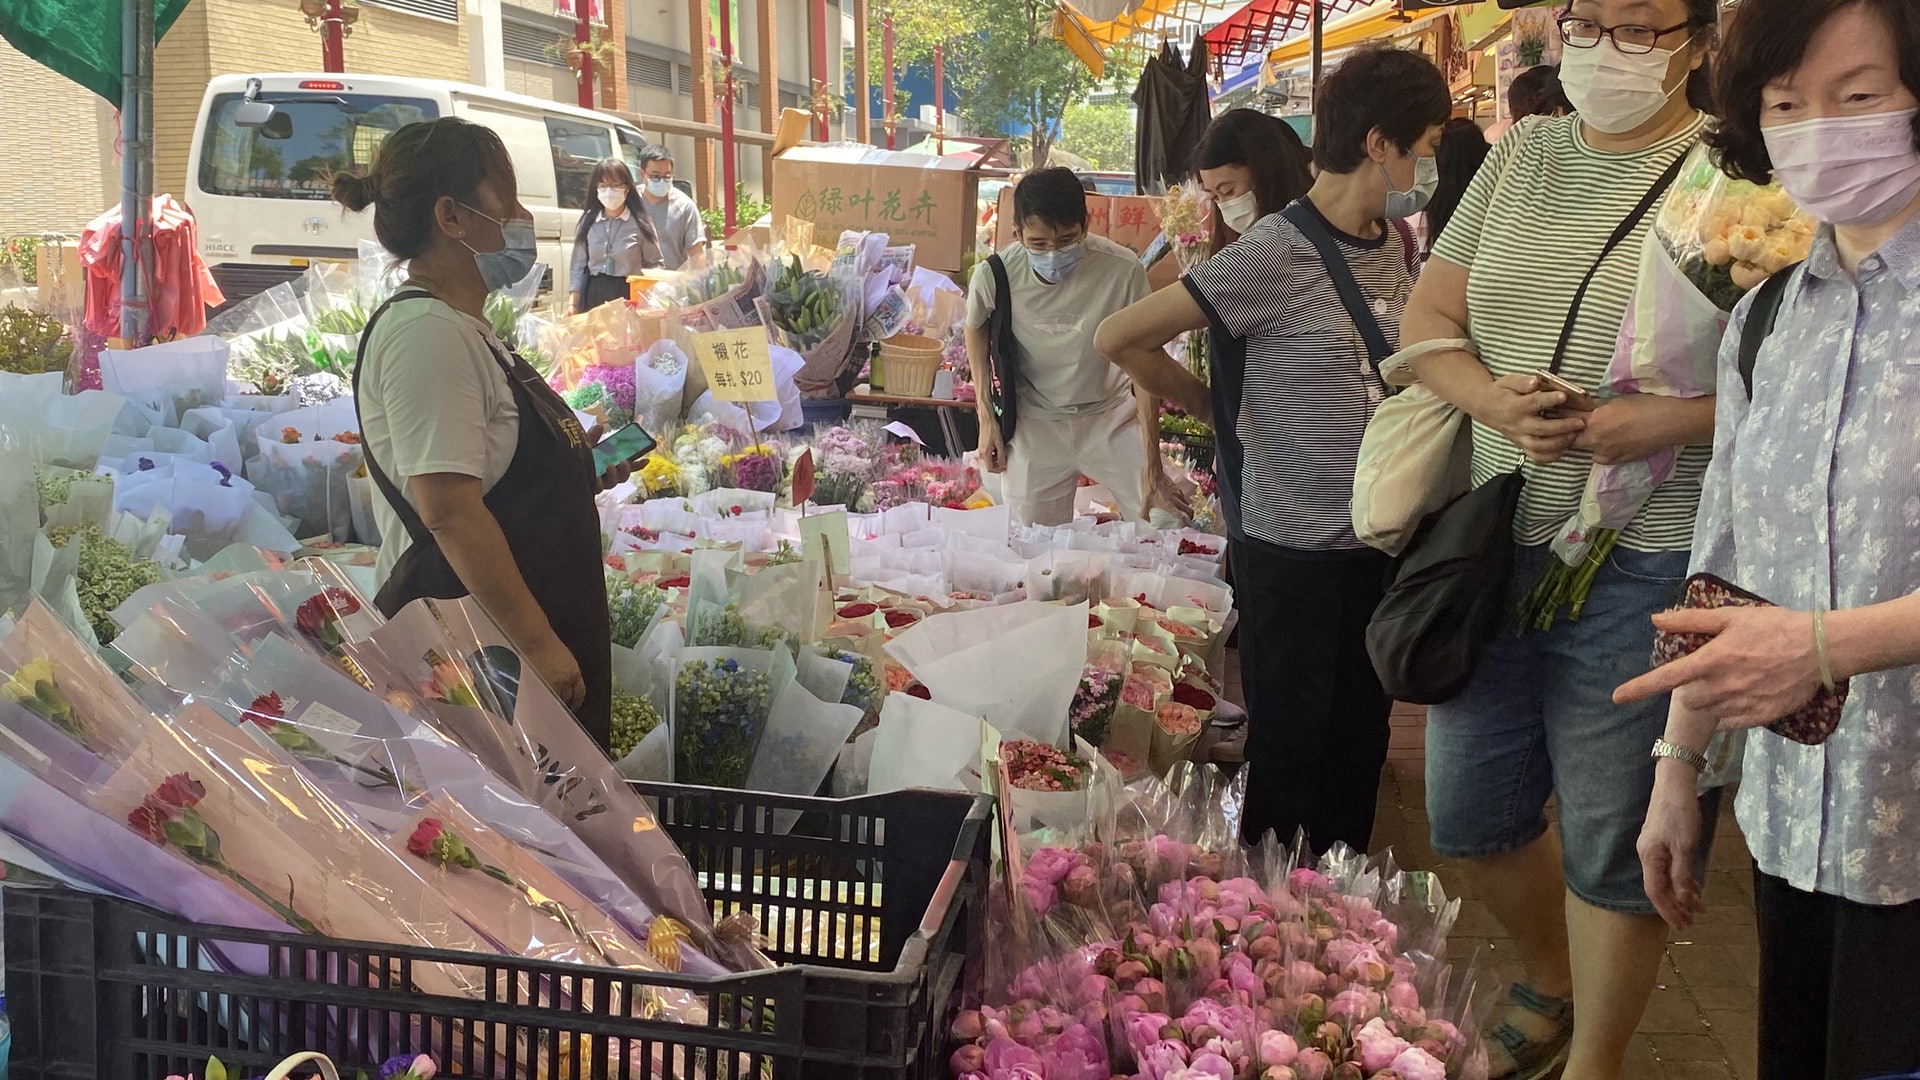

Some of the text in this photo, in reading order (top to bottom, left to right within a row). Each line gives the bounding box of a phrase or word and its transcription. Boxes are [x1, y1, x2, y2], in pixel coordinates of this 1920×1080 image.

[818, 186, 938, 226] 绿叶花卉
[740, 369, 763, 387] $20
